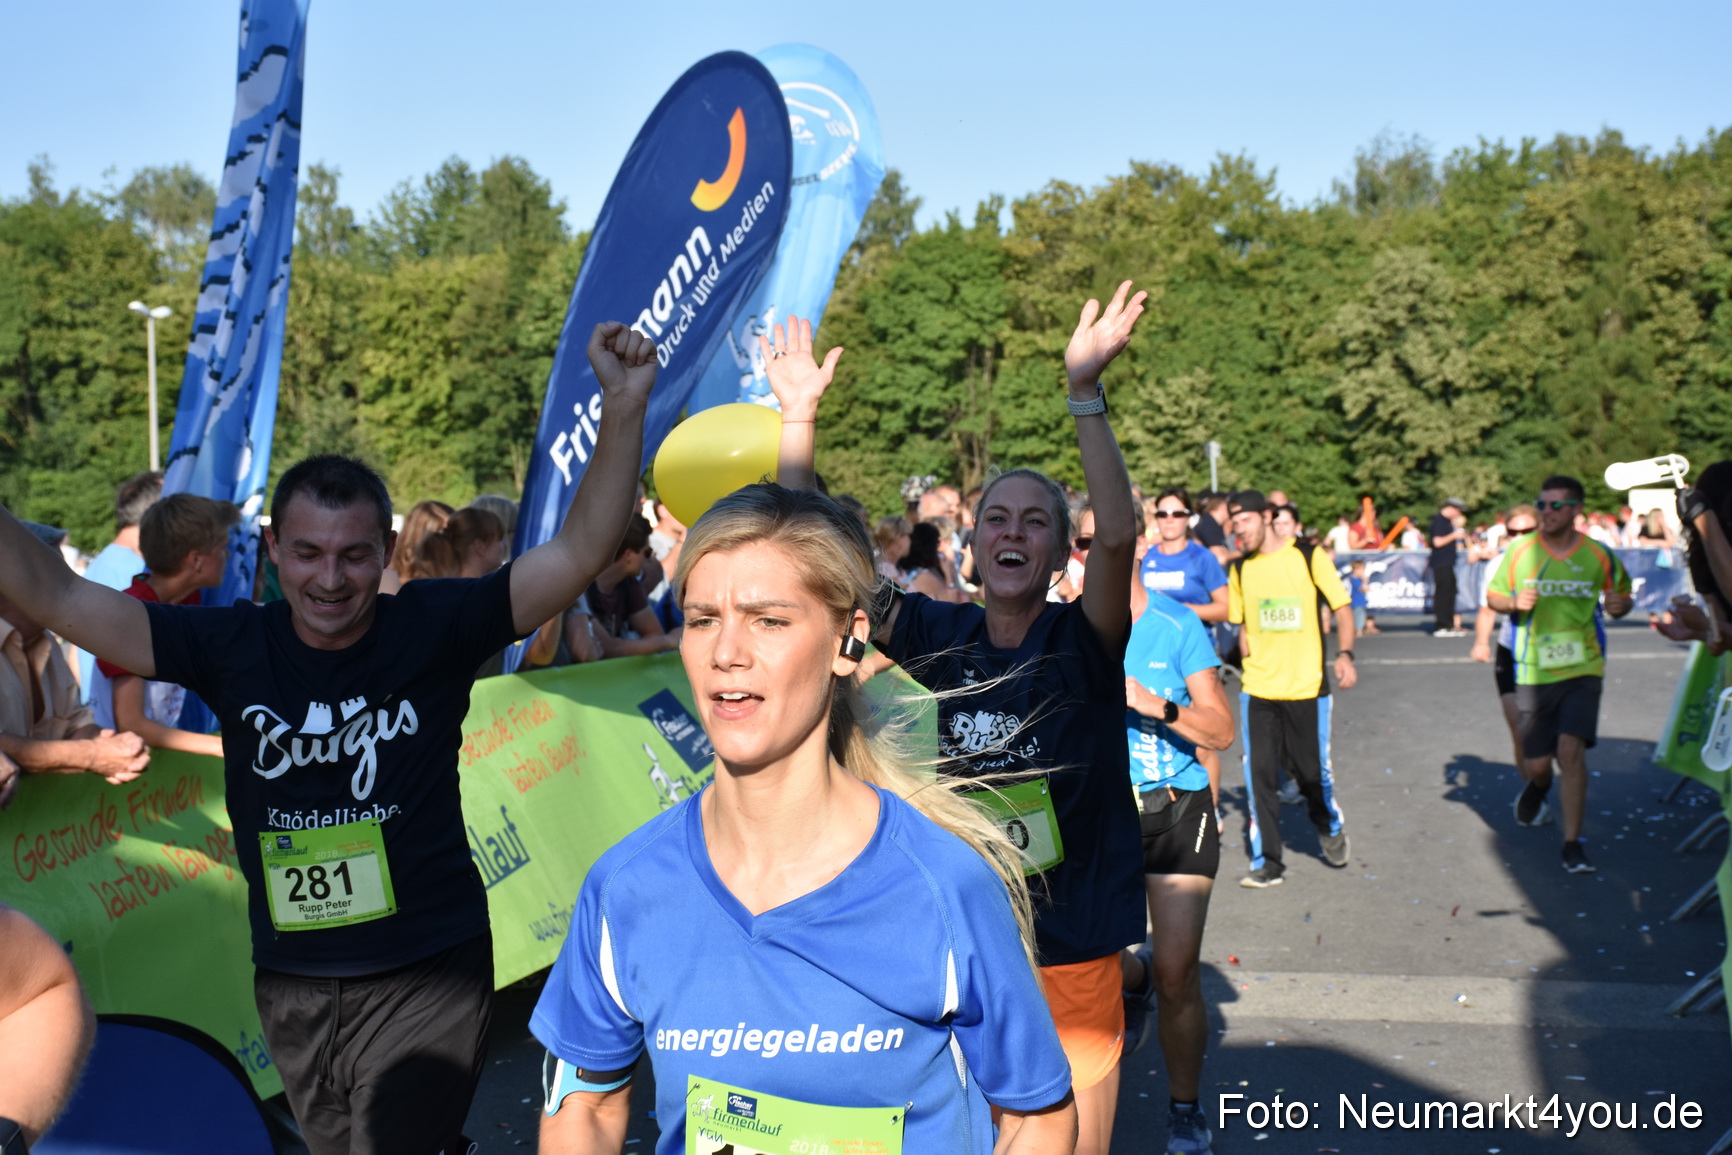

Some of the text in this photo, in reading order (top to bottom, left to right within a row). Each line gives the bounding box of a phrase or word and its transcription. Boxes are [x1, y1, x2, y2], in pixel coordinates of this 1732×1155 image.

[657, 181, 775, 369] Druck und Medien
[1264, 608, 1296, 622] 1688
[508, 698, 558, 737] Firmen
[241, 698, 419, 801] Burgis
[1019, 736, 1041, 759] is!
[13, 774, 205, 883] Gesunde Firmen
[314, 850, 339, 860] 2018
[88, 856, 179, 922] laufen
[285, 861, 353, 902] 281
[298, 899, 352, 913] Rupp Peter
[304, 913, 325, 921] Burgis
[327, 910, 348, 919] GmbH
[656, 1022, 904, 1058] energiegeladen
[713, 1107, 784, 1137] firmenlauf
